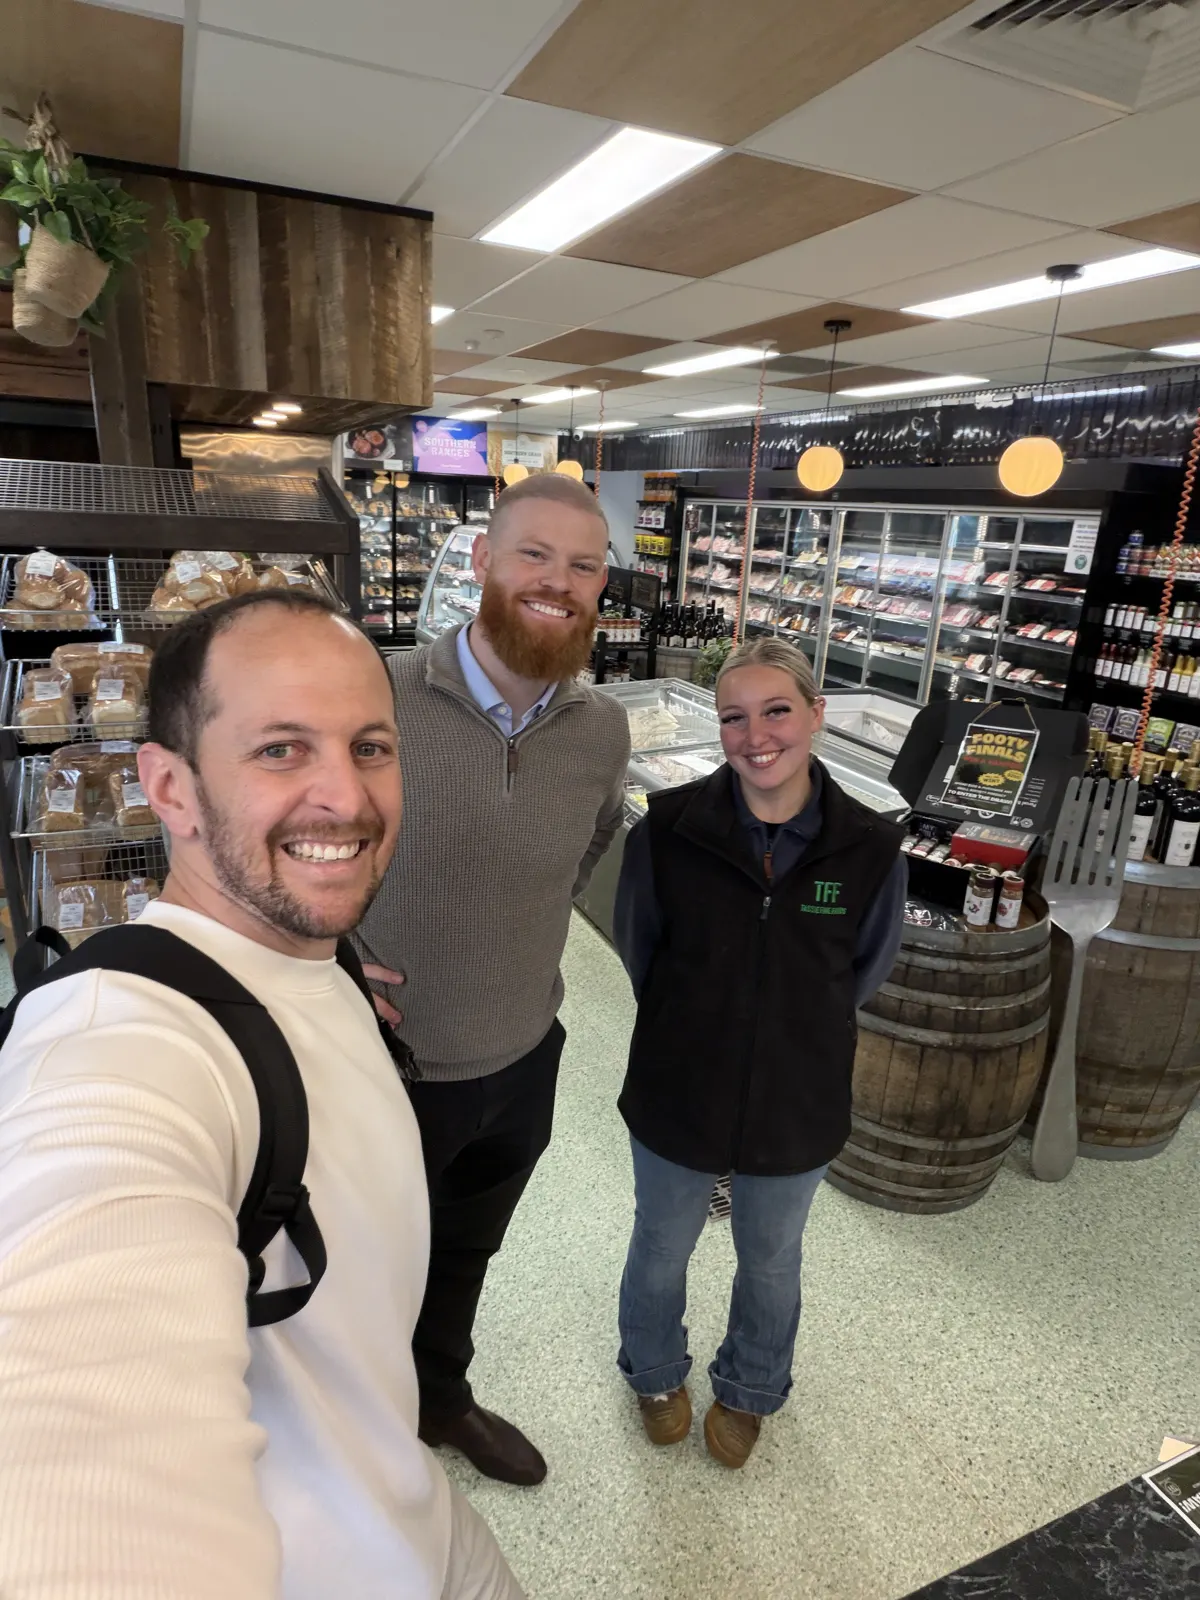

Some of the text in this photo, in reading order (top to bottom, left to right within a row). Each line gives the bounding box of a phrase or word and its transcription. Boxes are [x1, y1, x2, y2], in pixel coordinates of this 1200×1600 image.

[424, 437, 477, 449] SOUTHERN
[432, 446, 470, 458] RANGES
[972, 733, 1030, 750] FOOTY
[966, 745, 1027, 763] FINALS
[956, 790, 978, 798] ENTER
[814, 880, 843, 903] TFF
[1178, 1491, 1200, 1513] AW!
